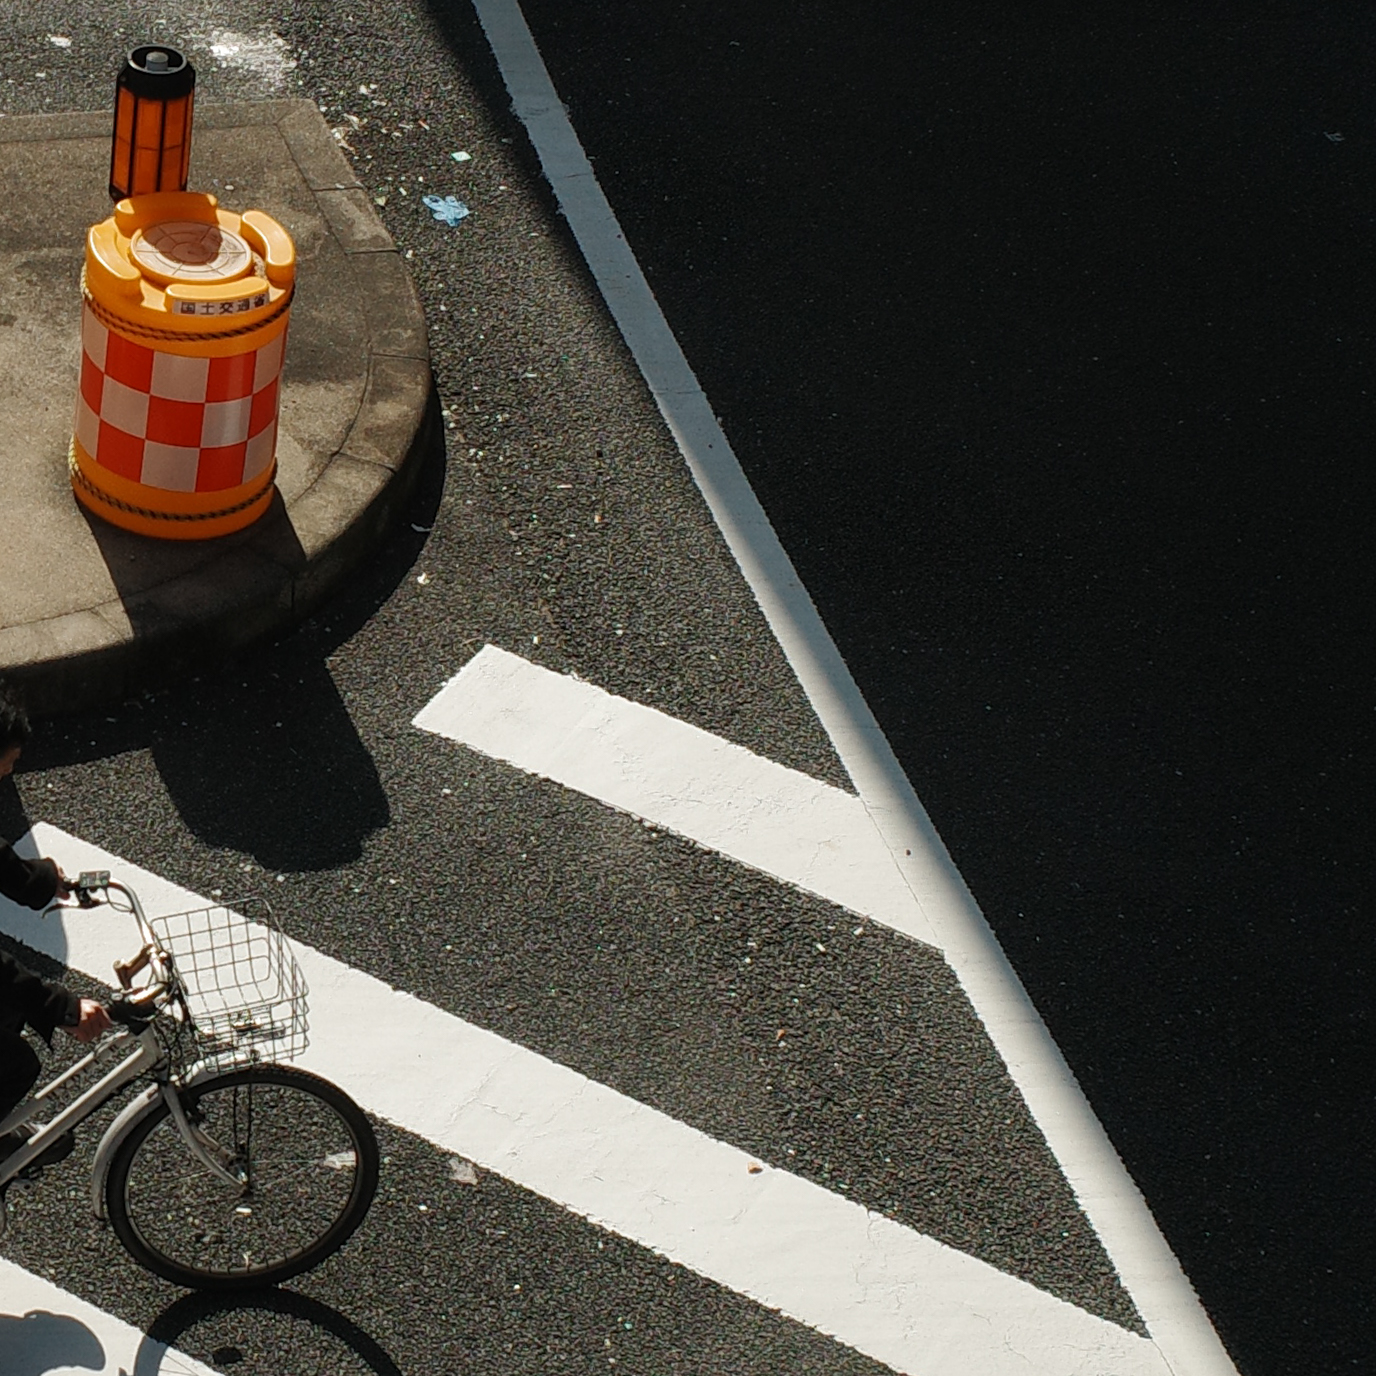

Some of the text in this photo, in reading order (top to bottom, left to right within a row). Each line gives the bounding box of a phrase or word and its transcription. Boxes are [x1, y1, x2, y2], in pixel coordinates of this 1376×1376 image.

[180, 293, 267, 316] 国土交通省
